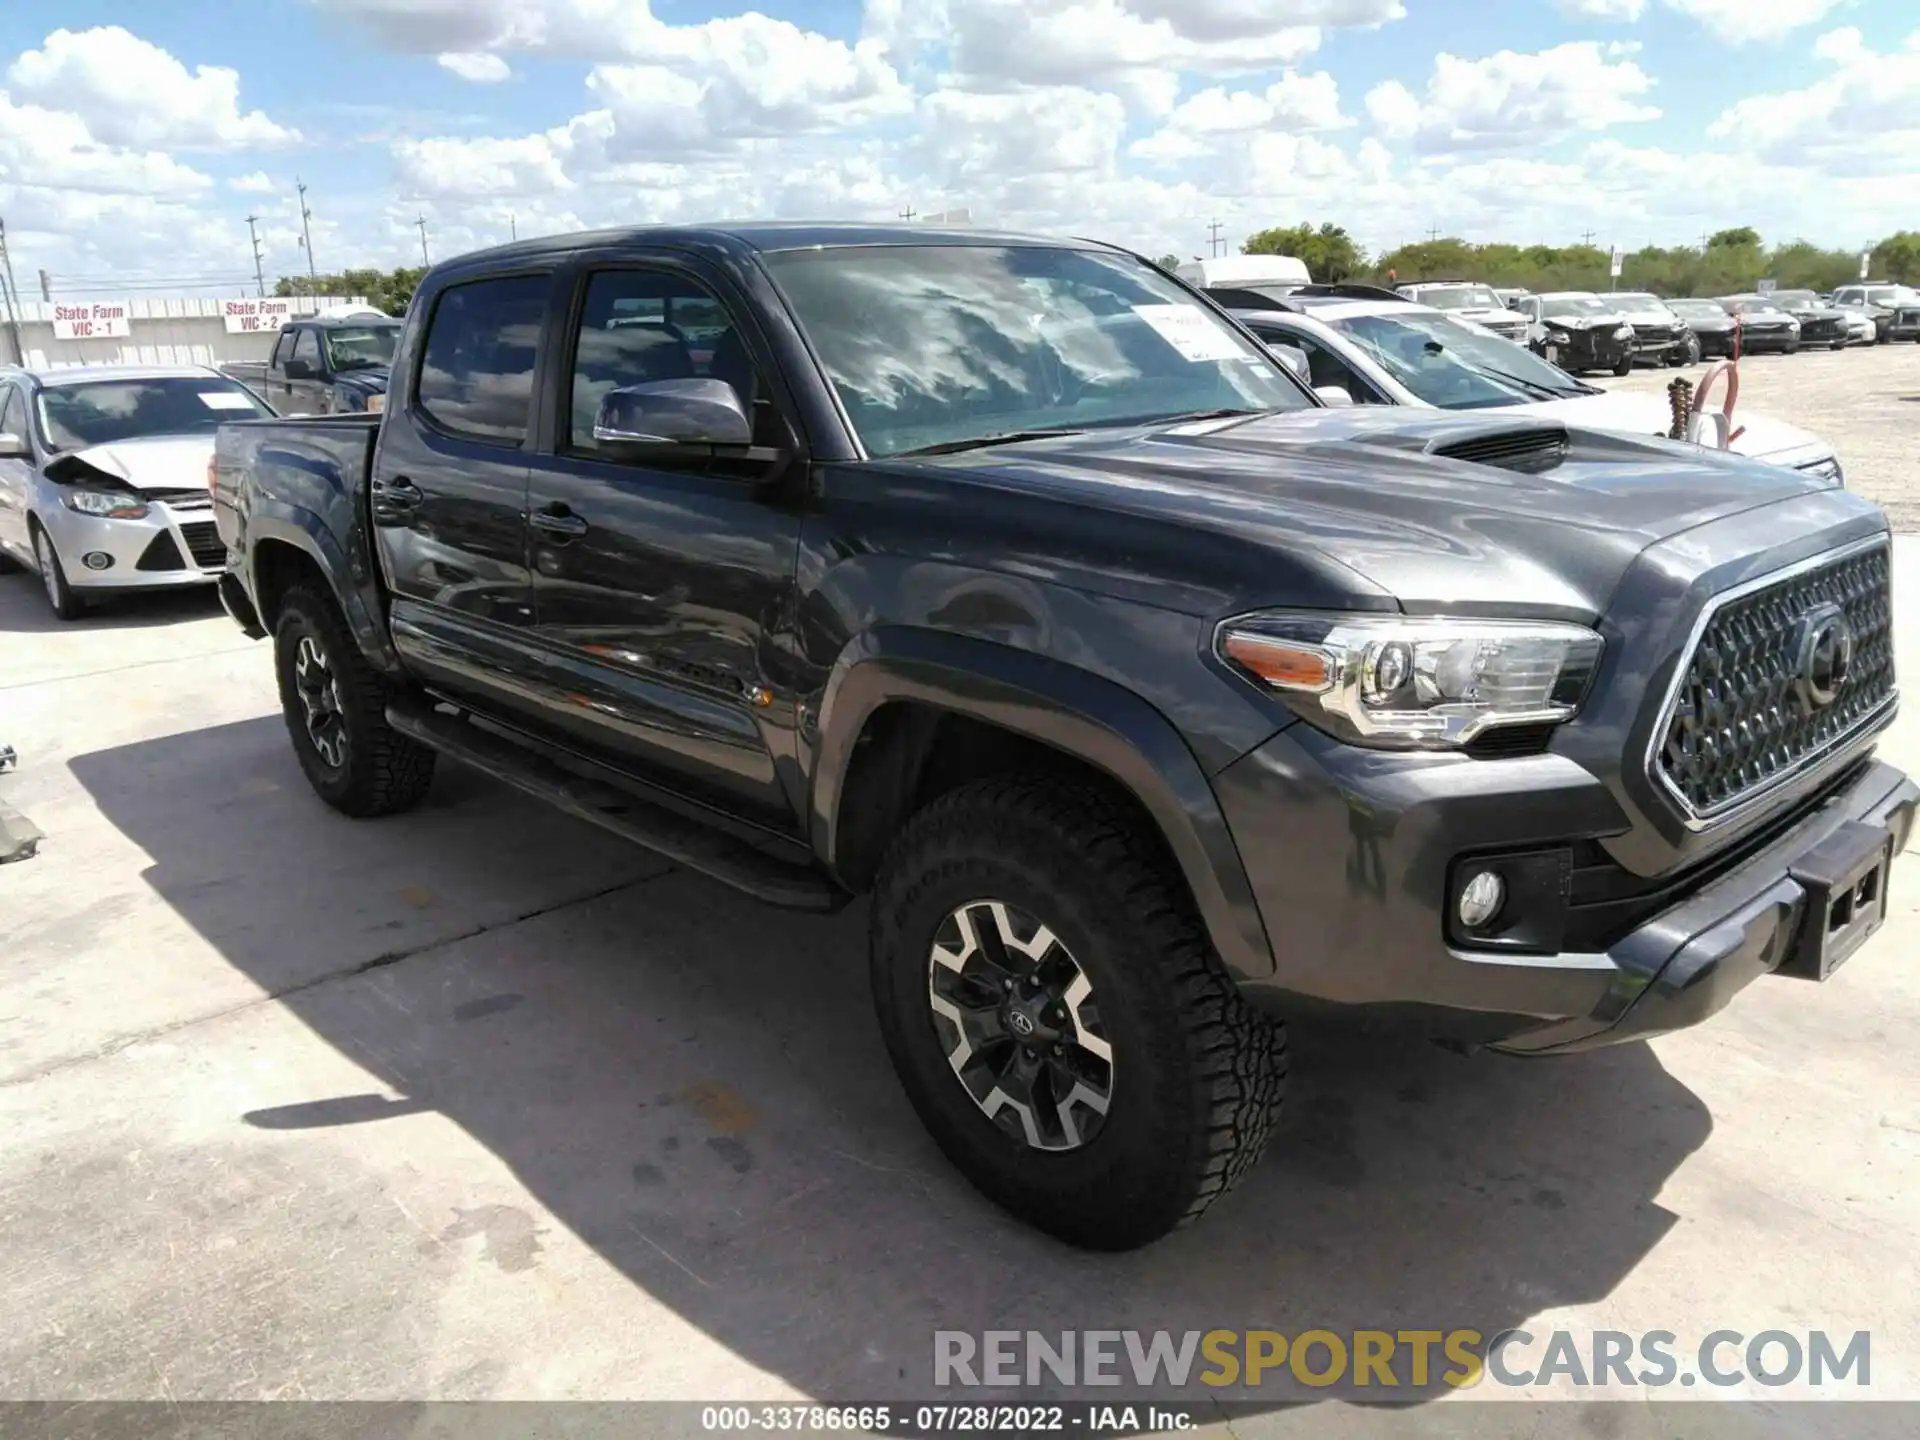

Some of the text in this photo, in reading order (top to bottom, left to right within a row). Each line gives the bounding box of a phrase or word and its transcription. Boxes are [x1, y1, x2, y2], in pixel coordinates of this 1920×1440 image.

[55, 304, 124, 320] State Farm
[226, 301, 287, 315] State Farm
[71, 321, 93, 336] VIC
[106, 321, 112, 335] 1
[240, 316, 260, 330] VIC
[270, 316, 278, 329] 2
